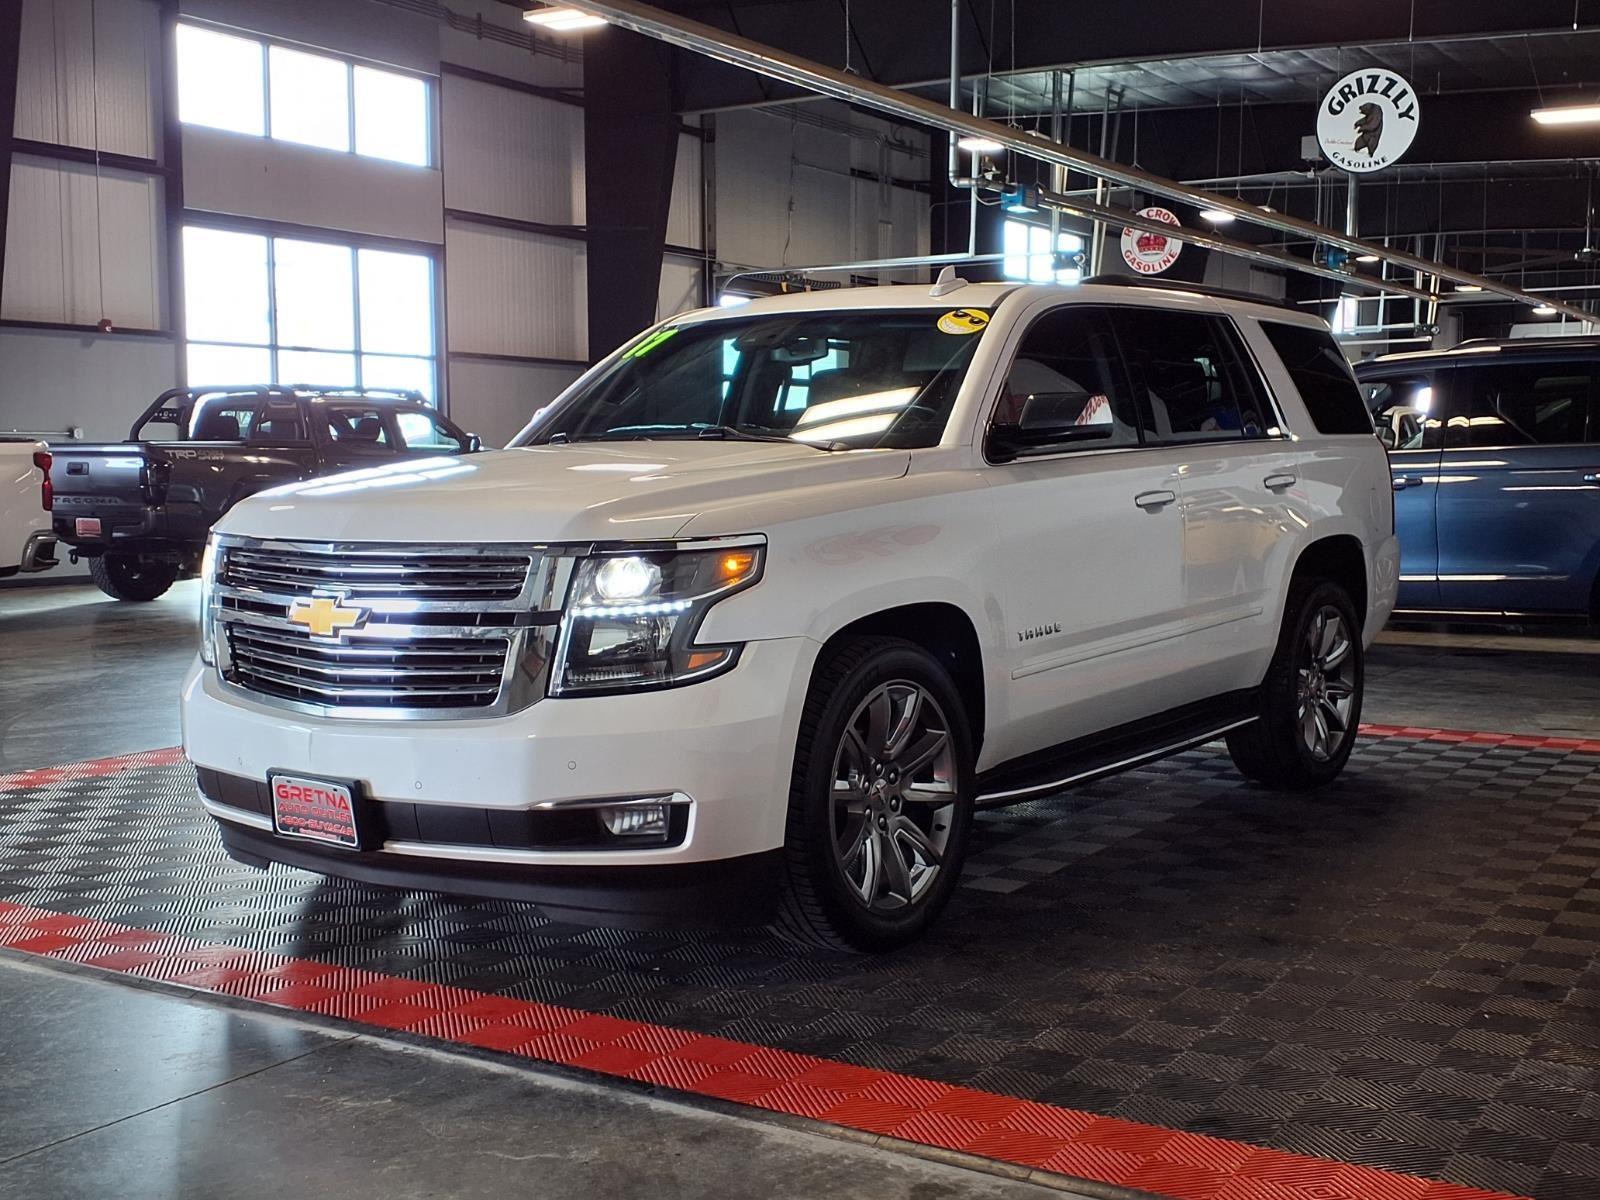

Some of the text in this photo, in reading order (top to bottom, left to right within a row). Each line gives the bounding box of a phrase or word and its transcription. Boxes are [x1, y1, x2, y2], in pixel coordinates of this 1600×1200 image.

[1327, 74, 1415, 121] GRIZZLY
[1332, 151, 1388, 169] GASOLINE
[1146, 208, 1177, 226] CROW
[1124, 249, 1178, 273] GASOLINE
[163, 449, 197, 460] TRD
[54, 496, 118, 504] TACOMA
[1017, 621, 1062, 642] TAHOE
[276, 783, 350, 811] GRETNA
[277, 802, 309, 815] AUTO
